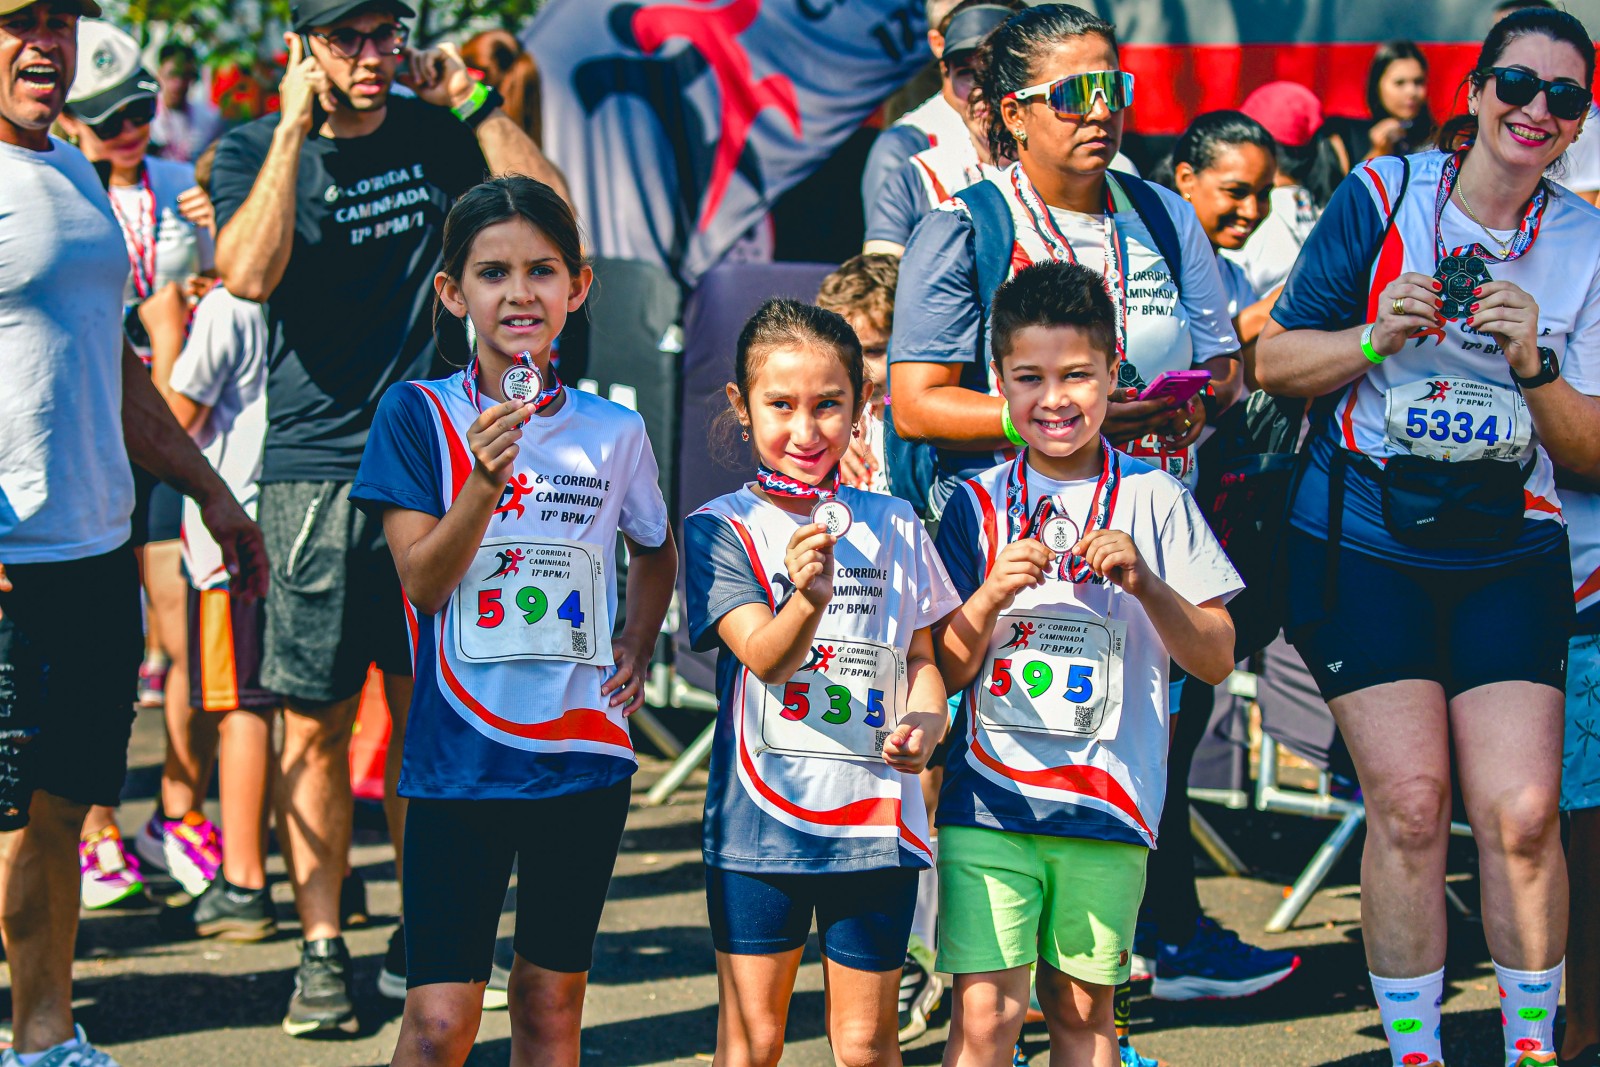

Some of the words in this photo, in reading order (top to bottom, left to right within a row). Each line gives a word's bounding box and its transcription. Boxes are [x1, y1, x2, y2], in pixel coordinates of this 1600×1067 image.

[413, 164, 424, 179] E
[335, 186, 430, 223] CAMNHADA
[1125, 288, 1175, 299] AMINHADA
[1461, 383, 1489, 391] CORRIDA
[1454, 390, 1493, 399] CAMINHADA
[1405, 407, 1500, 447] 5334
[553, 475, 602, 490] CORRIDA
[604, 480, 611, 491] E
[535, 491, 604, 510] CAMINHADA
[535, 549, 566, 557] CORRIDA
[529, 558, 571, 567] CAMINHADA
[837, 567, 881, 579] CORRIDA
[882, 569, 888, 580] E
[832, 585, 883, 598] AMINHADA
[1047, 624, 1081, 633] CORRIDA
[1039, 632, 1085, 643] CAMINHADA
[846, 647, 874, 657] CORRIDA
[838, 656, 877, 667] CAMINHADA
